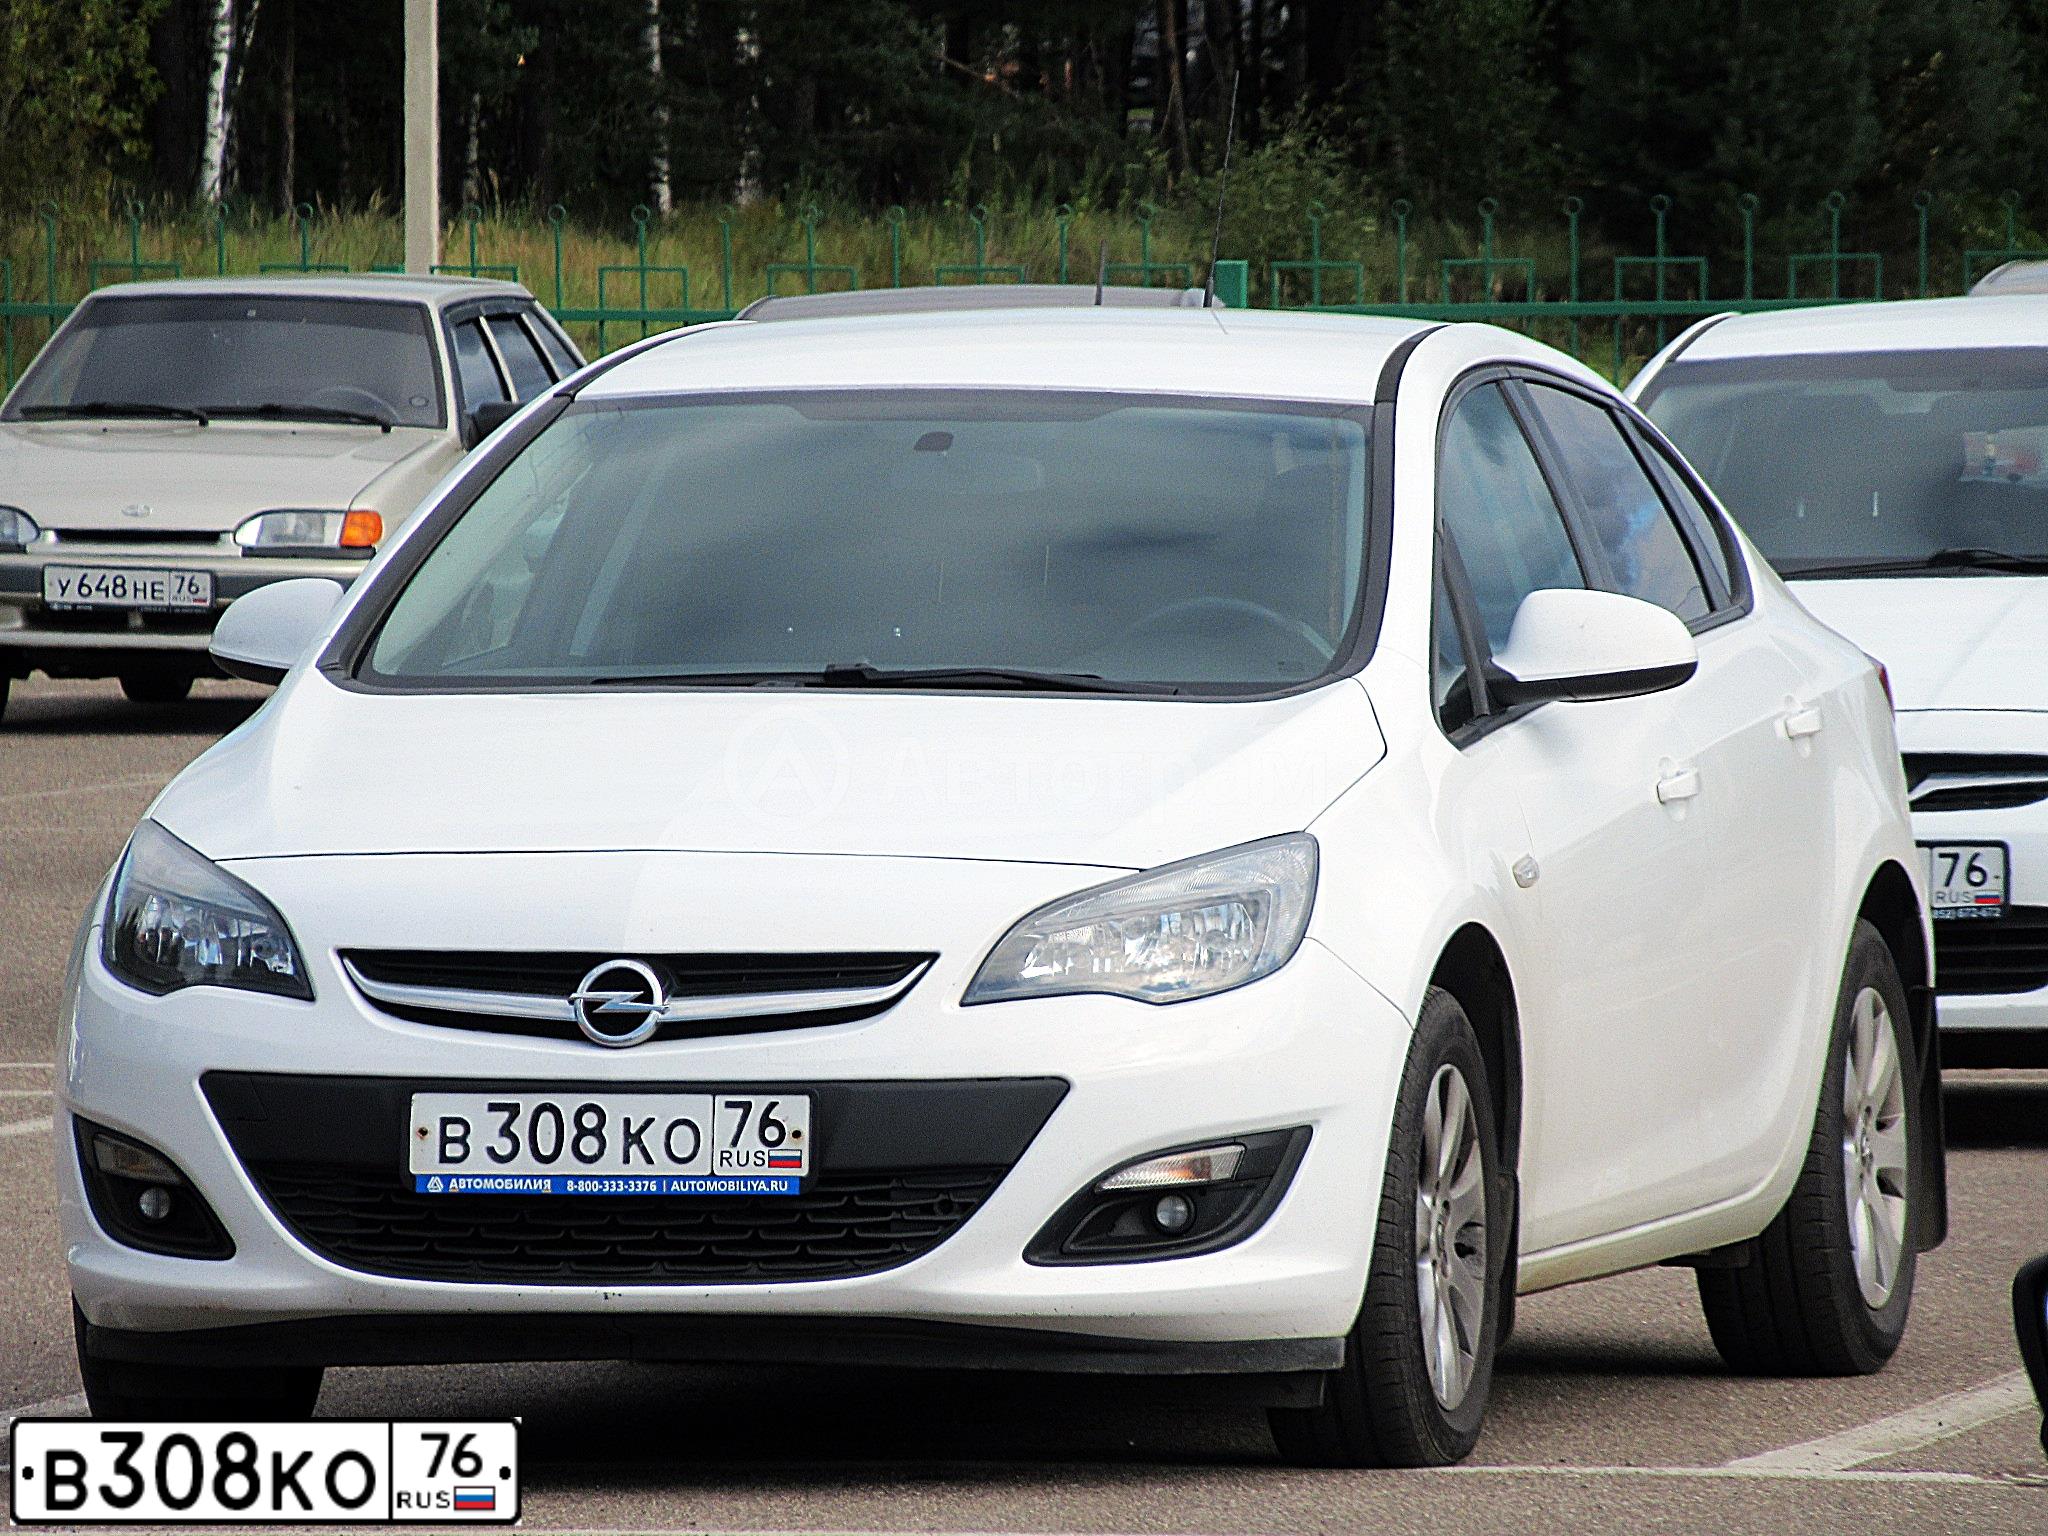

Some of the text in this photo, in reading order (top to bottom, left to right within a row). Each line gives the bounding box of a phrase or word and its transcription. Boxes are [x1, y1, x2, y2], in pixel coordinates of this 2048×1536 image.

[174, 575, 200, 595] 76
[1938, 852, 1988, 887] 76
[1935, 891, 1971, 904] RUS
[723, 1100, 787, 1149] 76
[718, 1150, 766, 1167] RUS
[449, 1178, 788, 1192] АВТОМОБИЛИЯ 8-800-333-3376 AUTOMOBILIYA.RU
